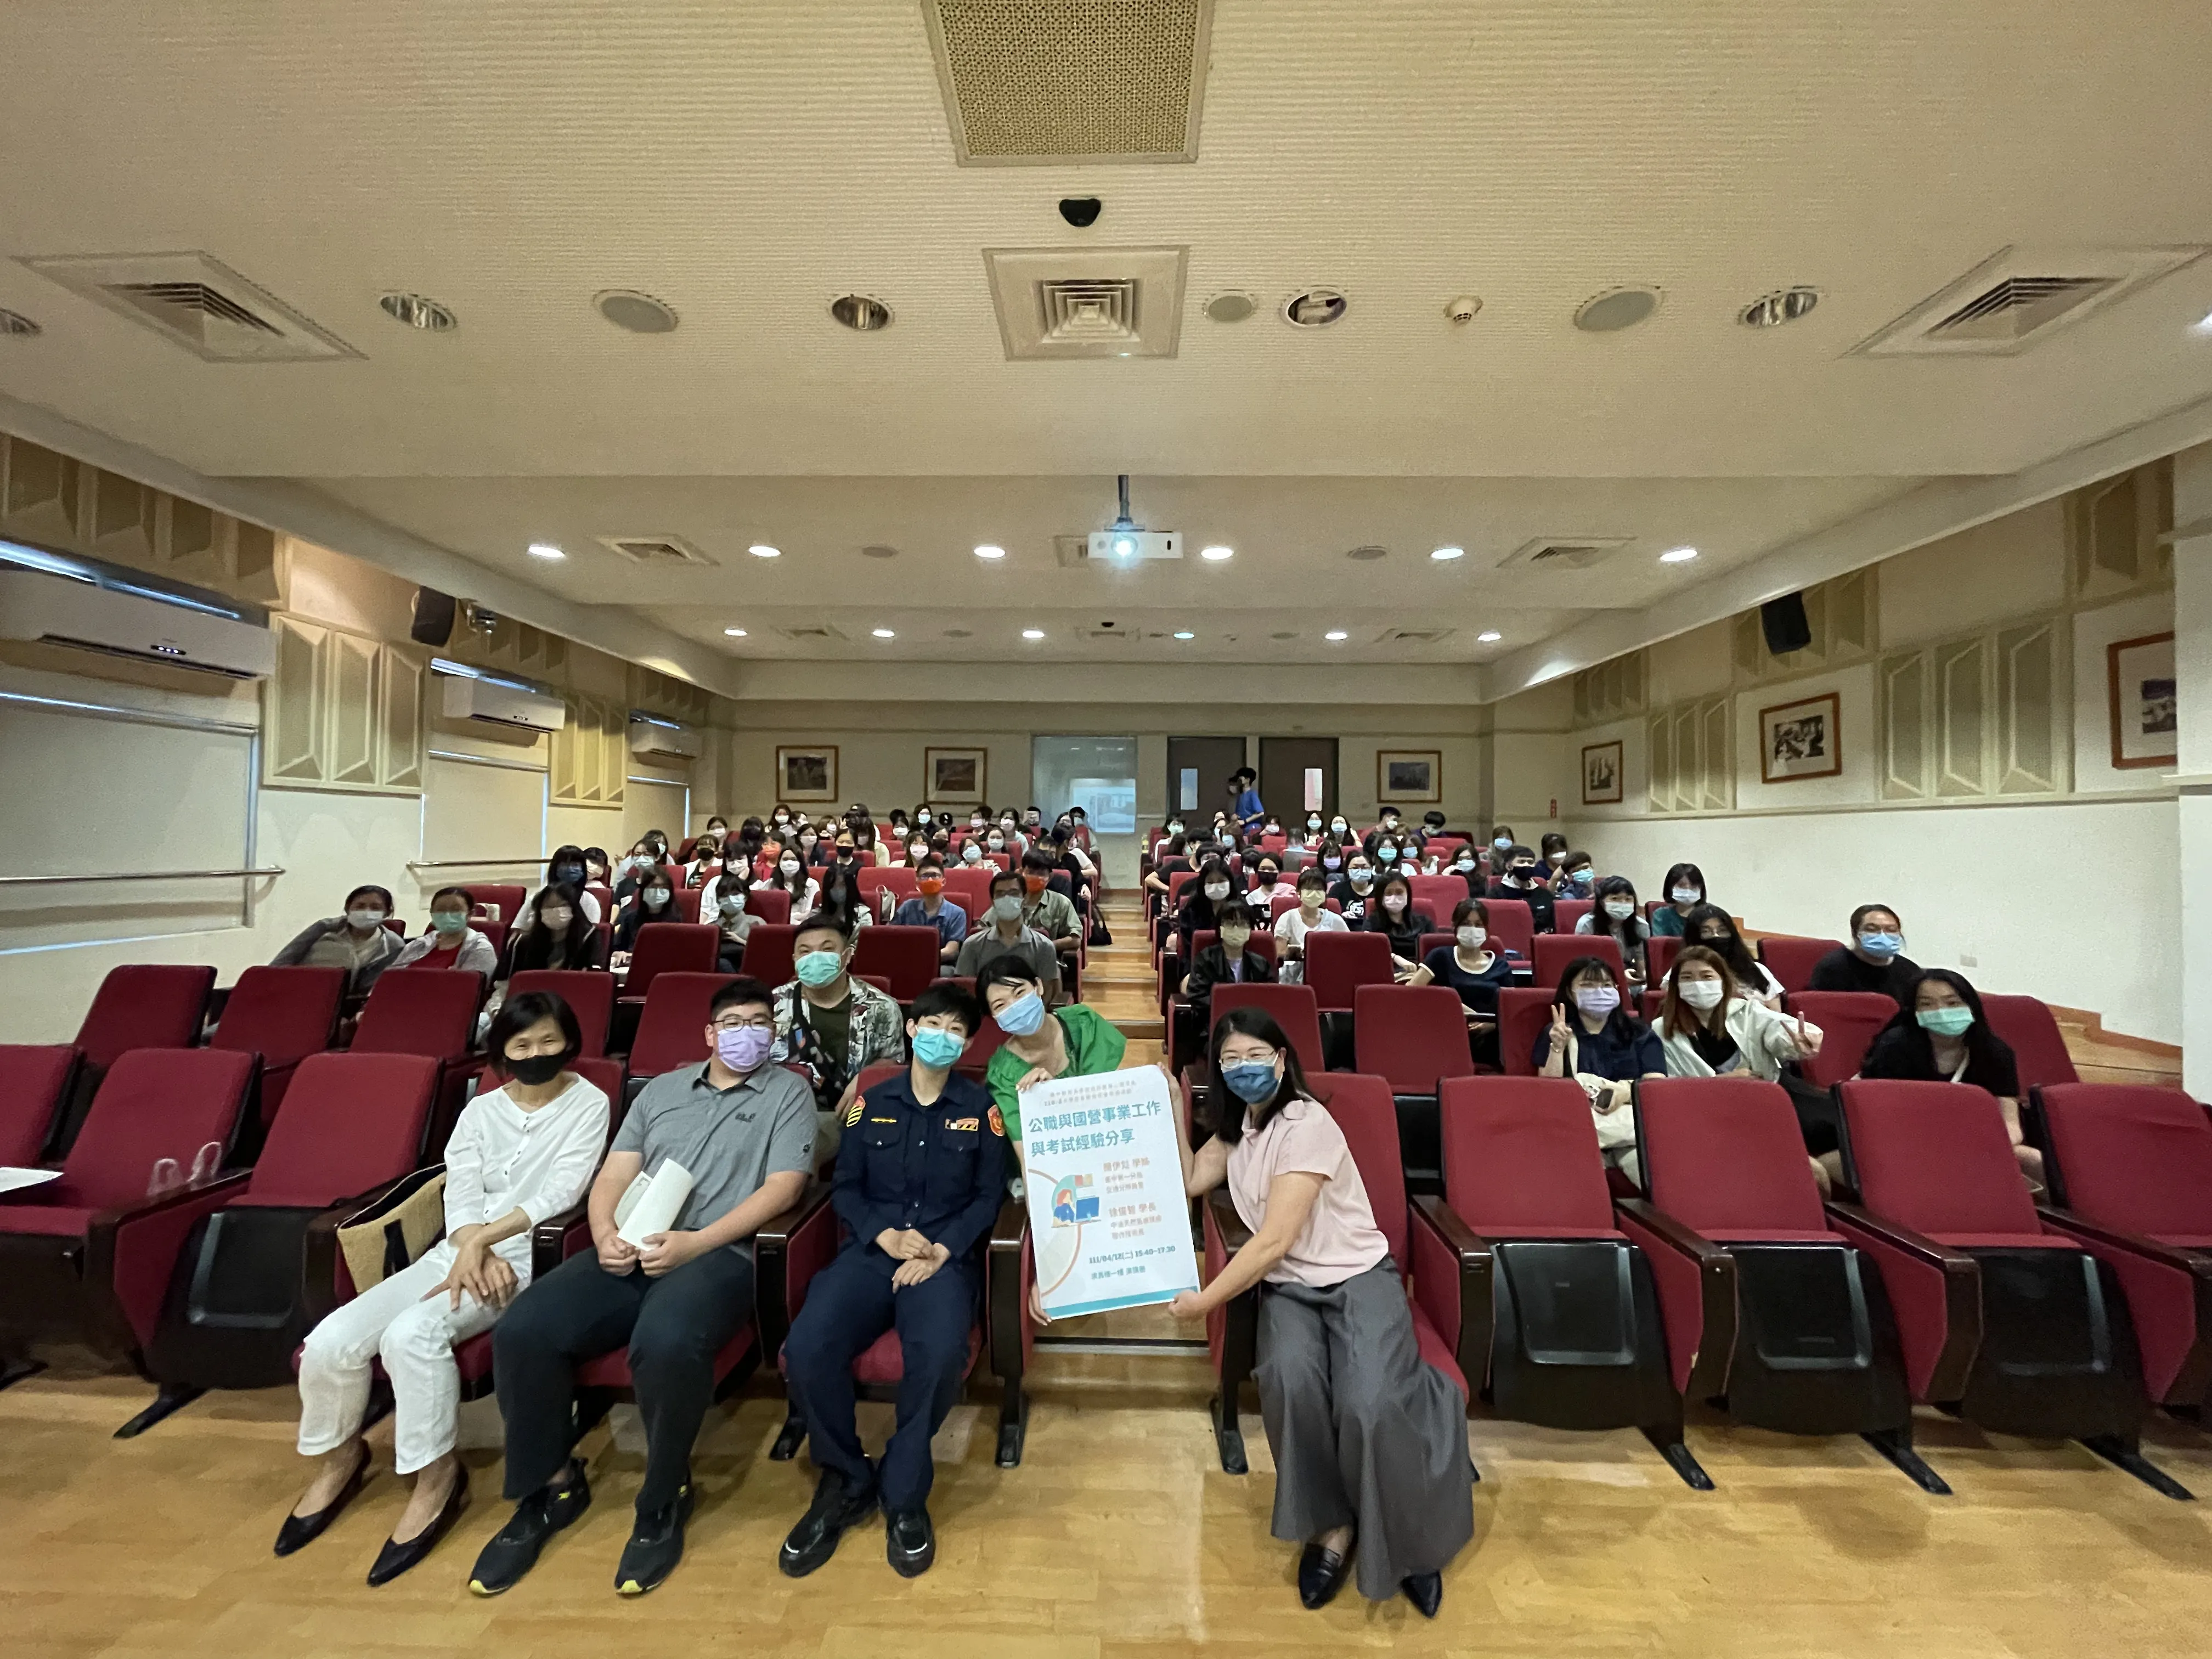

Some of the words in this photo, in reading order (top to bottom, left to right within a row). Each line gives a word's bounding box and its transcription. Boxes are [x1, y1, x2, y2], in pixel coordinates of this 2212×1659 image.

[1029, 1100, 1161, 1132] 公職與國營事業工作
[1031, 1128, 1135, 1157] 與考試經驗分享
